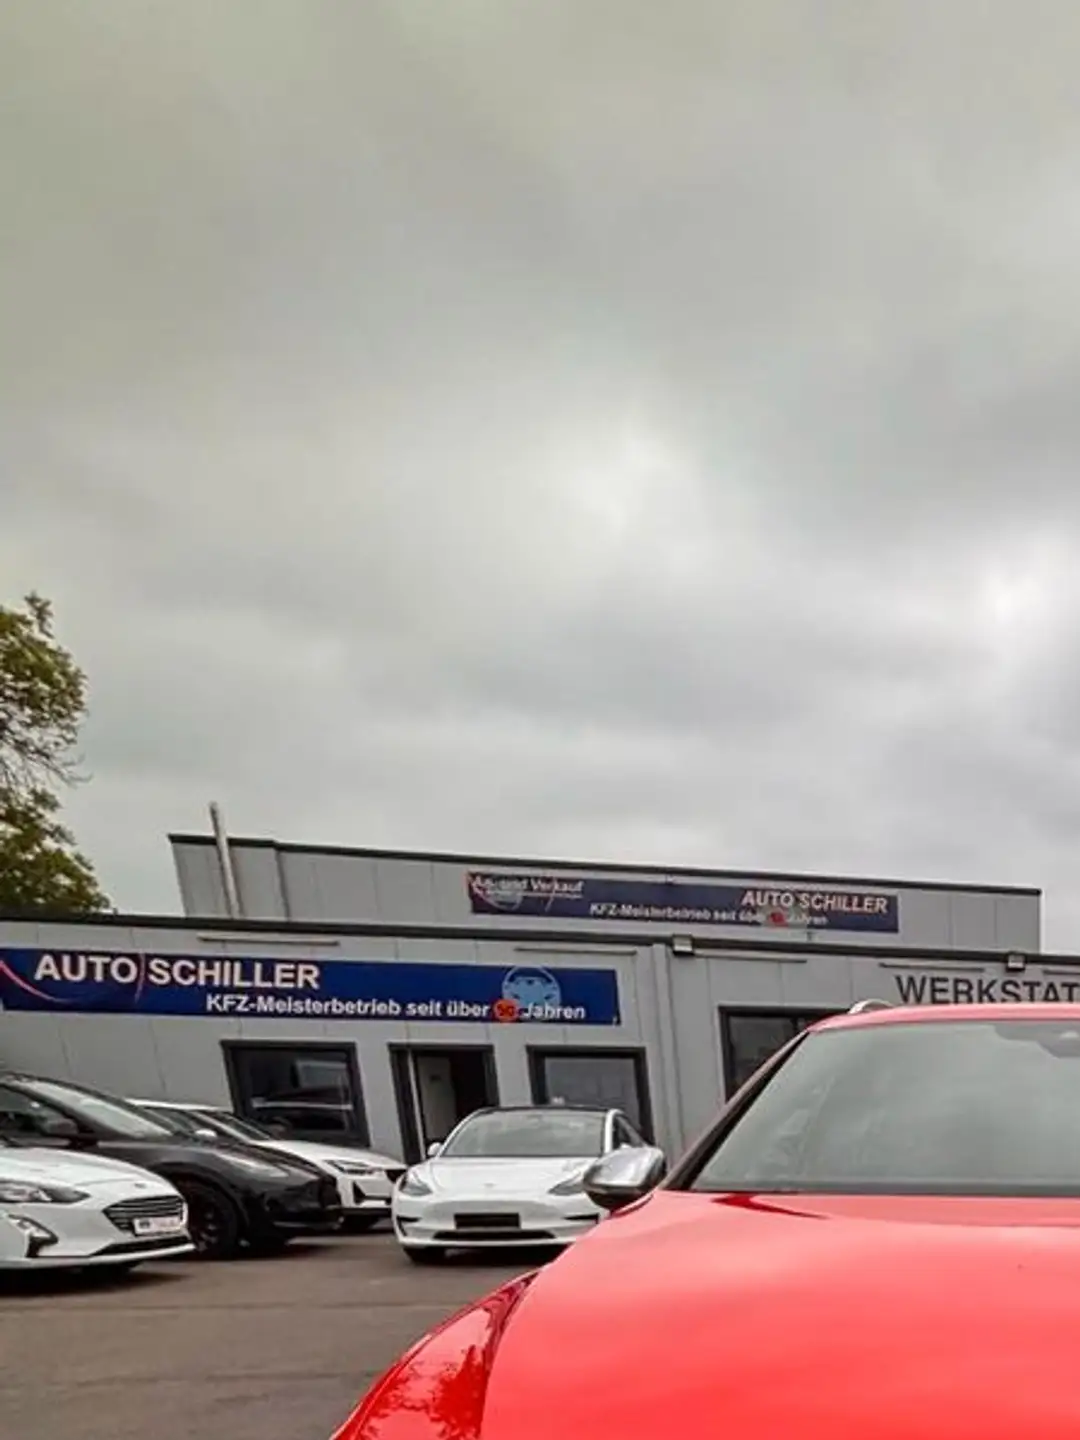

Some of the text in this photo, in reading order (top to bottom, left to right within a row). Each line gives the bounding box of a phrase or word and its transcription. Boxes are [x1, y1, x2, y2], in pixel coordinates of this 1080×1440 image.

[530, 877, 584, 892] Verkauf
[741, 890, 888, 914] AUTO SCHILLER
[34, 954, 320, 989] AUTO SCHILLER
[206, 994, 401, 1016] KFZ-Meisterbetrieb
[405, 1000, 441, 1017] seit
[446, 1000, 490, 1018] über
[522, 1002, 586, 1019] Jahren
